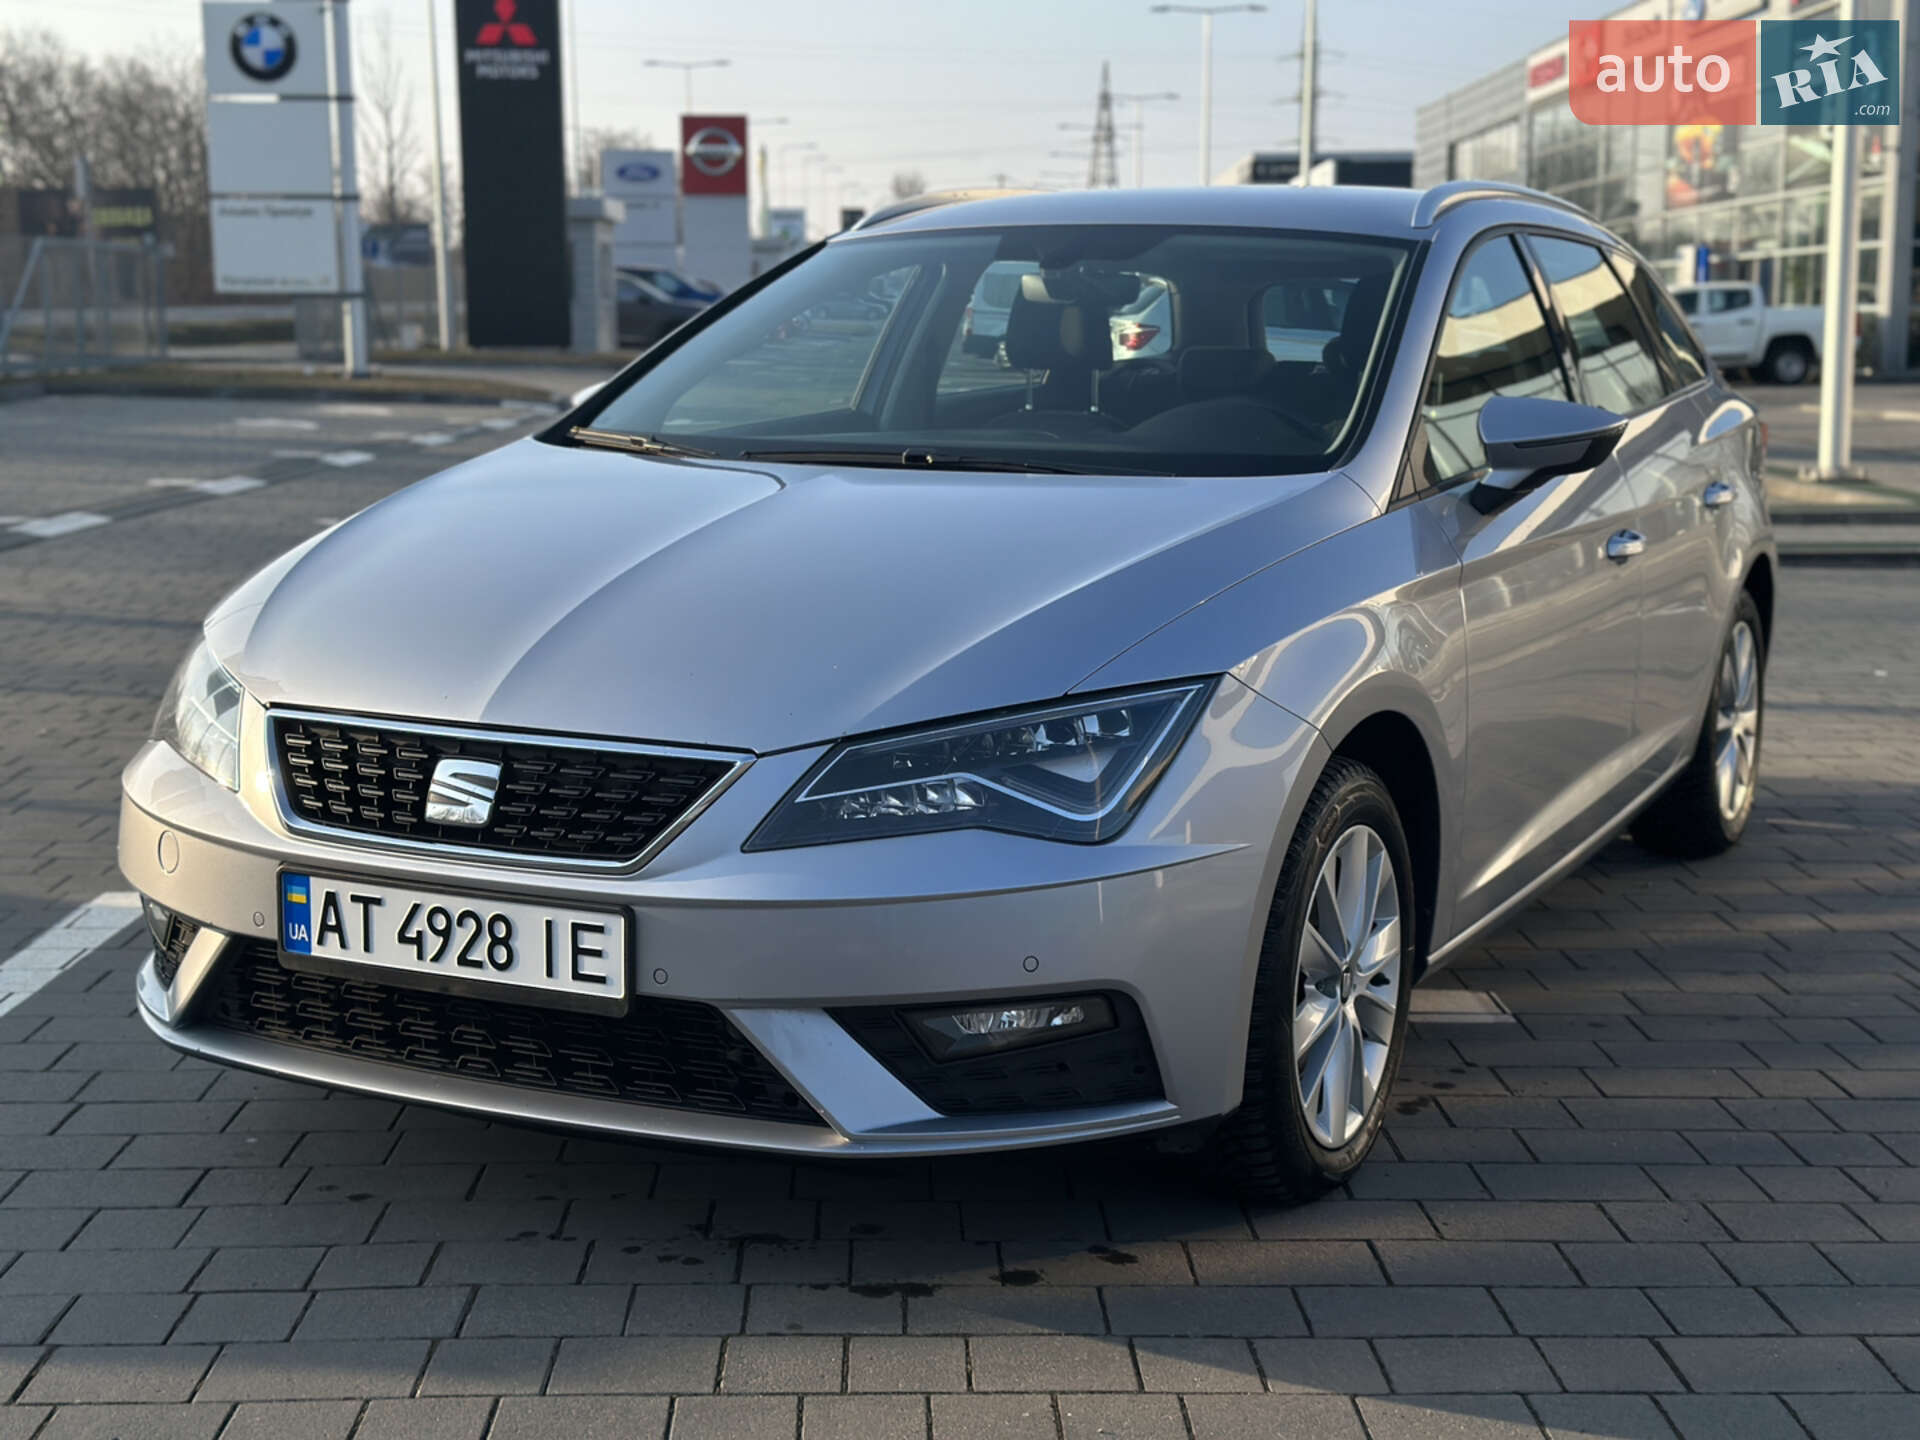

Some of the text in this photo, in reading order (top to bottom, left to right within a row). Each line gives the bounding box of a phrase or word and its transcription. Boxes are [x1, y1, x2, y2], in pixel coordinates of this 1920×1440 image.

[289, 922, 309, 942] UA
[316, 890, 607, 985] AT 4928 IE
